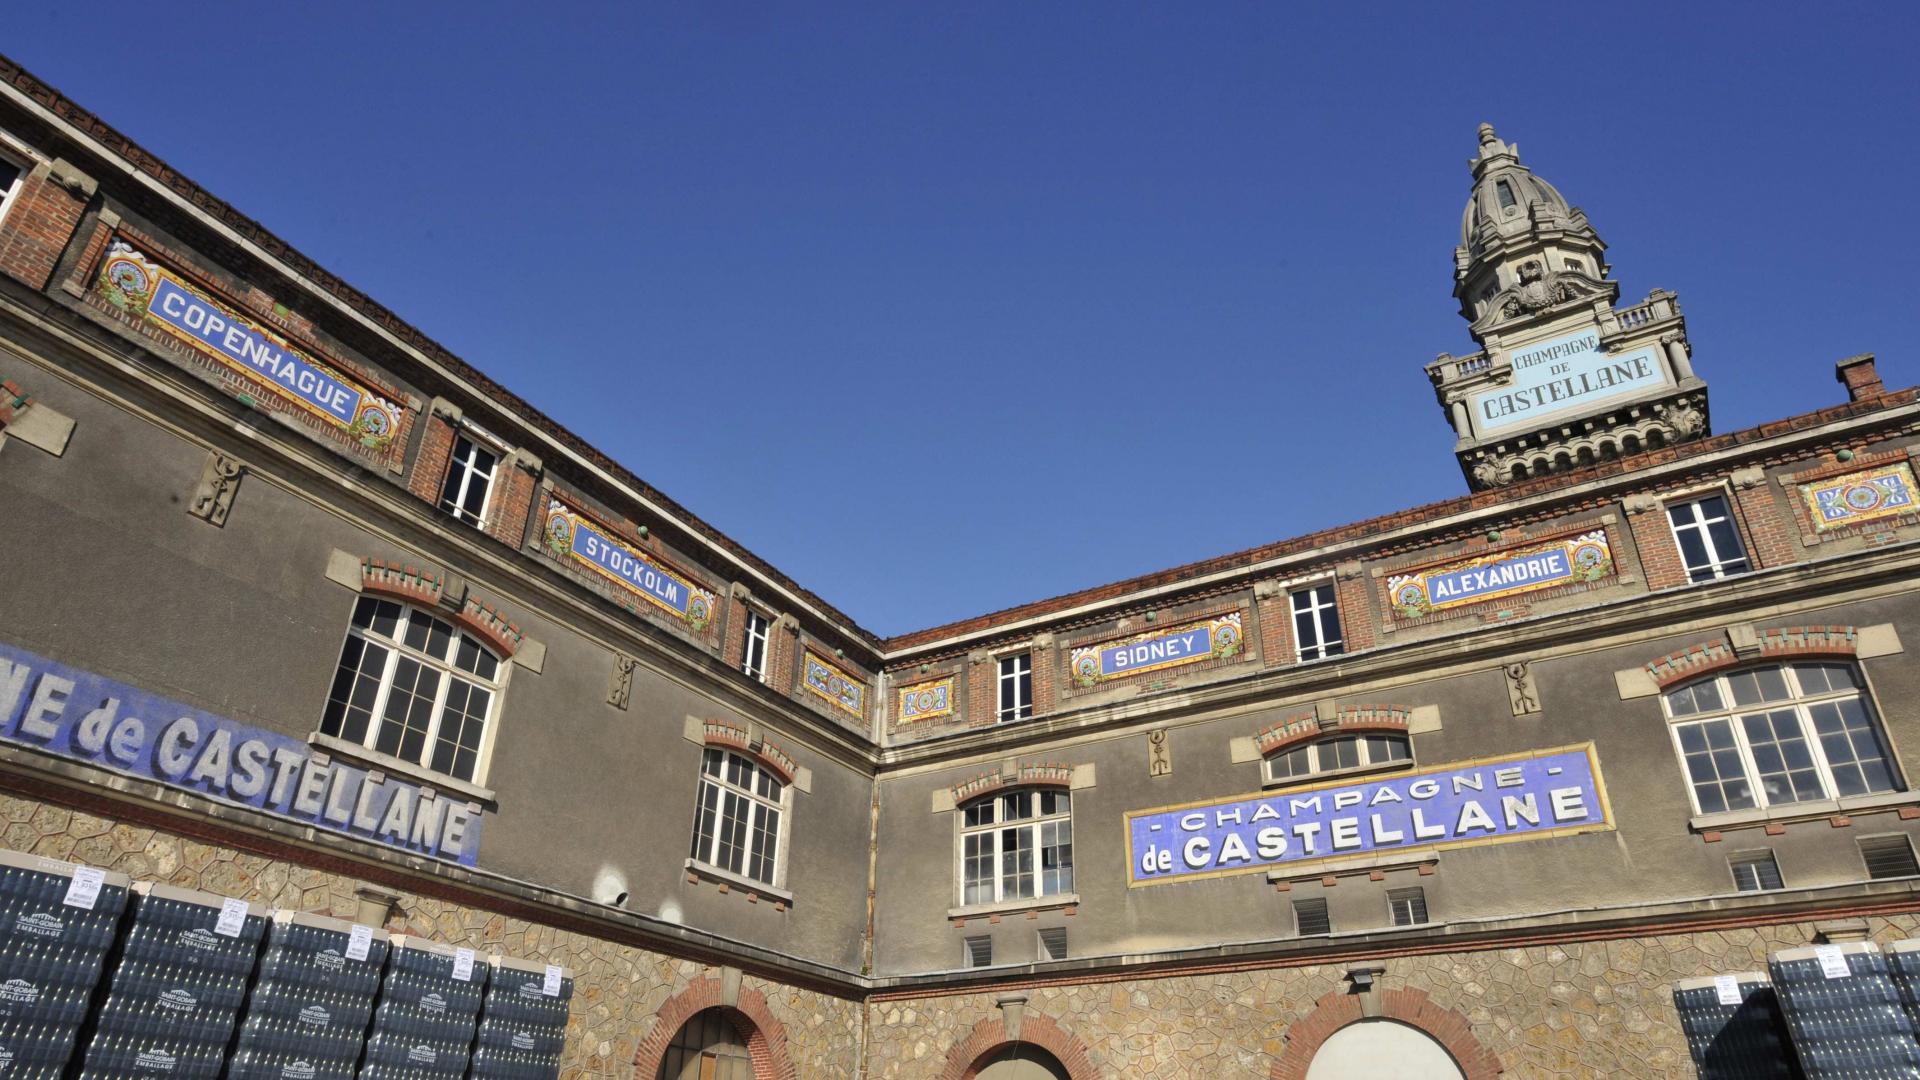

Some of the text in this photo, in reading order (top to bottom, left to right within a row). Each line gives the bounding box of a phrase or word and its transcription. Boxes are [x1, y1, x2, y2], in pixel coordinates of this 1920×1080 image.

[162, 292, 352, 415] COPENHAGUE
[1514, 335, 1598, 371] CHAMPAGNE
[1550, 361, 1571, 376] DE
[1483, 356, 1653, 421] CASTELLANE
[586, 537, 678, 604] STOCKOLM
[1436, 555, 1564, 599] ALEXANDRIE
[1115, 635, 1195, 668] SIDNEY
[77, 699, 145, 764] de
[156, 717, 468, 856] CASTELLANE
[1180, 766, 1526, 832] CHAMPAGNE
[1142, 786, 1589, 873] de CASTELLANE
[16, 924, 62, 937] EMBALLAGE
[20, 915, 64, 929] SAINT-GOBAIN
